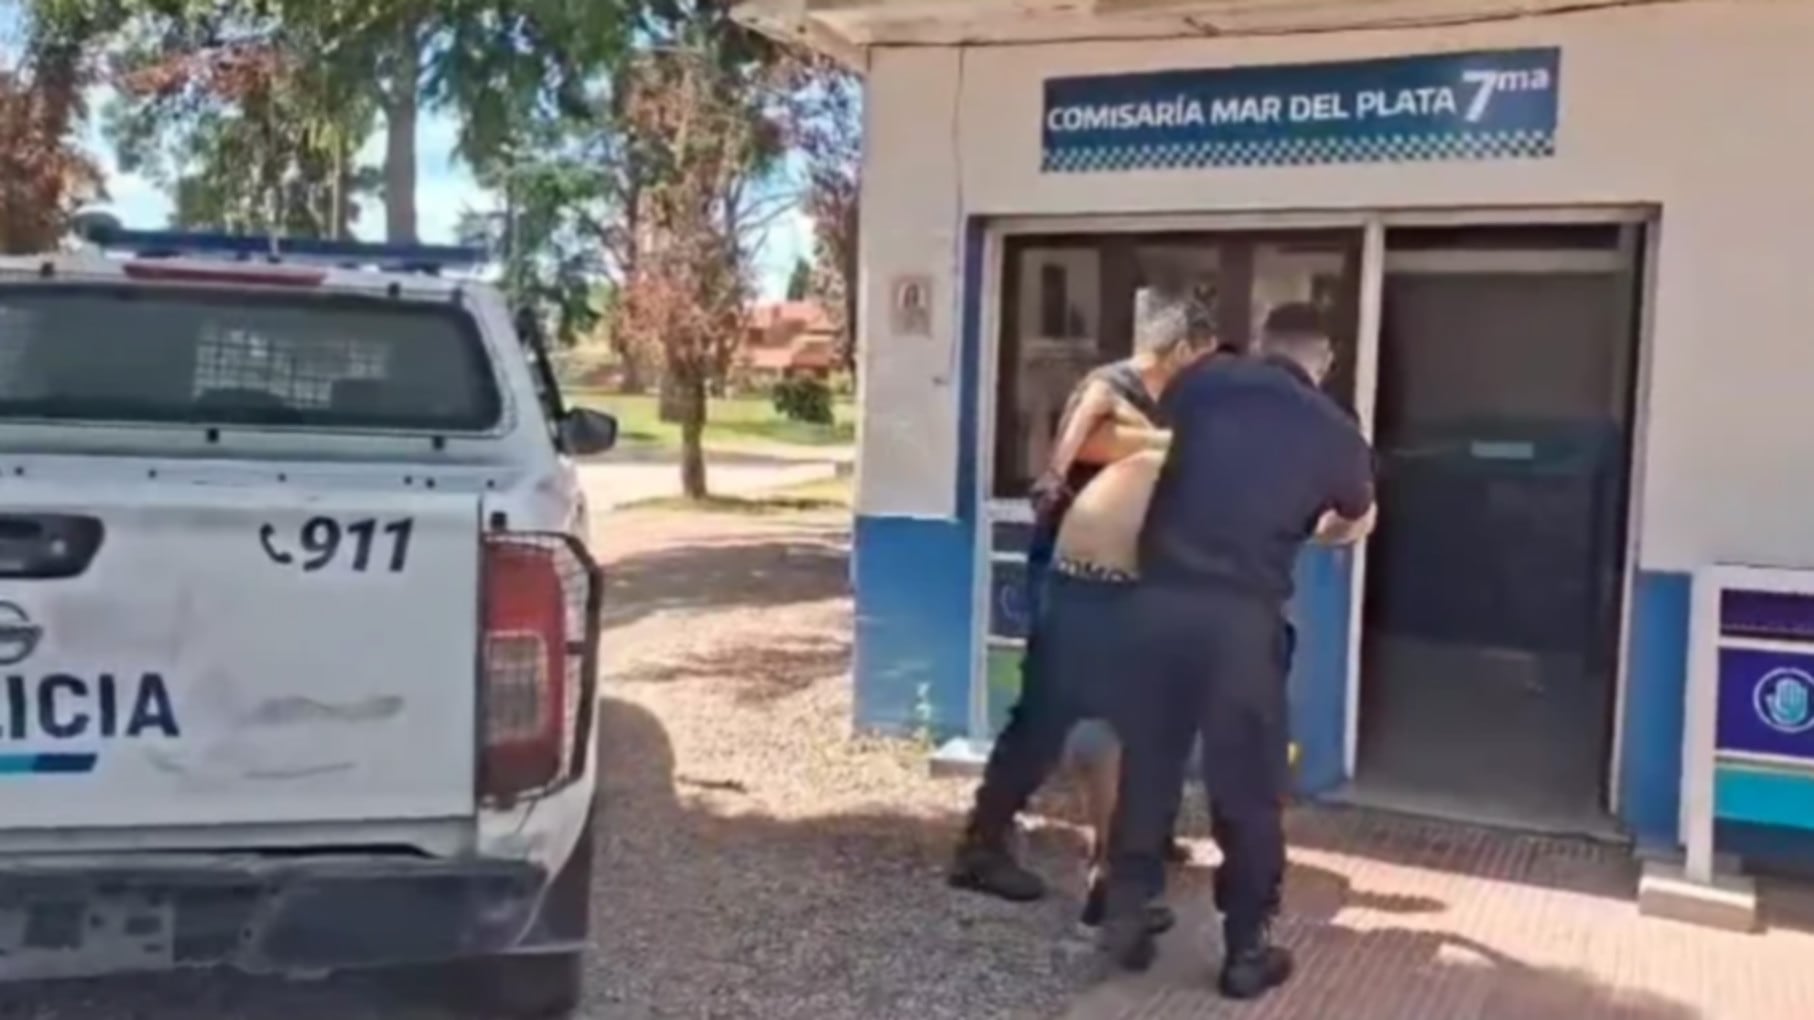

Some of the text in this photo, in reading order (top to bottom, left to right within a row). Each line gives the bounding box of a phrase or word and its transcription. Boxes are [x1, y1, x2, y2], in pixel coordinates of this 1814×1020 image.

[1047, 94, 1204, 131] COMISARÍA
[1210, 96, 1281, 125] MAR
[1289, 93, 1349, 122] DEL
[1355, 86, 1456, 120] PLATA
[301, 515, 414, 573] 911
[0, 672, 181, 740] ICIA
